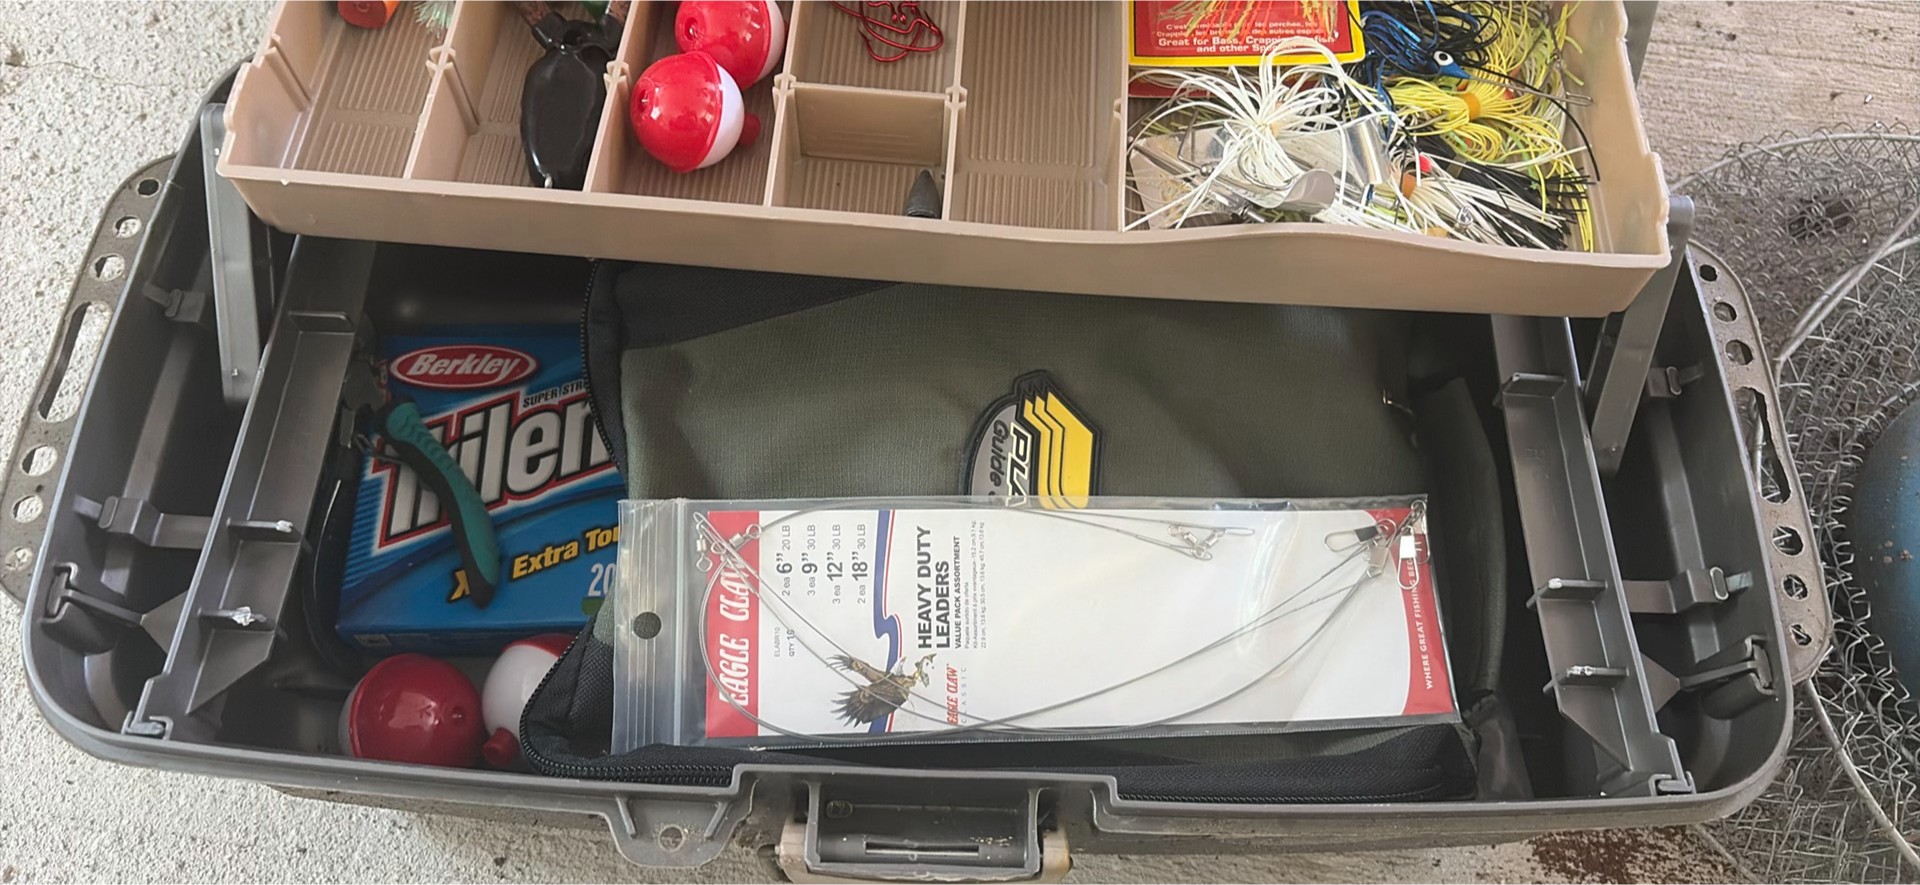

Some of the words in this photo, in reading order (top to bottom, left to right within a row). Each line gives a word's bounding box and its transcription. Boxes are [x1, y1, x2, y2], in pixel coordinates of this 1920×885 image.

[1158, 38, 1190, 46] Great
[1193, 37, 1209, 46] for
[1196, 45, 1216, 53] and
[1219, 44, 1249, 52] other
[409, 353, 521, 378] Berkley
[522, 387, 559, 409] SUPER
[988, 419, 1010, 487] Guide
[1005, 421, 1033, 507] PLA
[781, 525, 791, 538] LB
[806, 524, 815, 537] LB
[832, 524, 841, 537] LB
[857, 524, 866, 537] LB
[782, 538, 791, 551] 20
[807, 538, 816, 551] 30
[832, 538, 841, 550] 30
[857, 537, 866, 550] 30
[916, 525, 931, 578] DUTY
[512, 541, 579, 579] Extra
[953, 535, 961, 594] ASSORTMENT
[783, 576, 791, 589] ea
[808, 576, 816, 589] ea
[782, 588, 791, 597] 2
[807, 588, 816, 597] 3
[833, 584, 841, 597] ea
[858, 584, 866, 597] ea
[832, 597, 841, 605] 3
[857, 597, 866, 605] 2
[935, 560, 951, 649] LEADERS
[917, 583, 932, 649] HEAVY
[954, 620, 962, 649] VALUE
[1415, 621, 1428, 653] GREAT
[788, 642, 796, 657] QTY
[719, 632, 750, 706] EAGLE
[1420, 654, 1434, 690] WHERE
[946, 695, 959, 725] EAGLE
